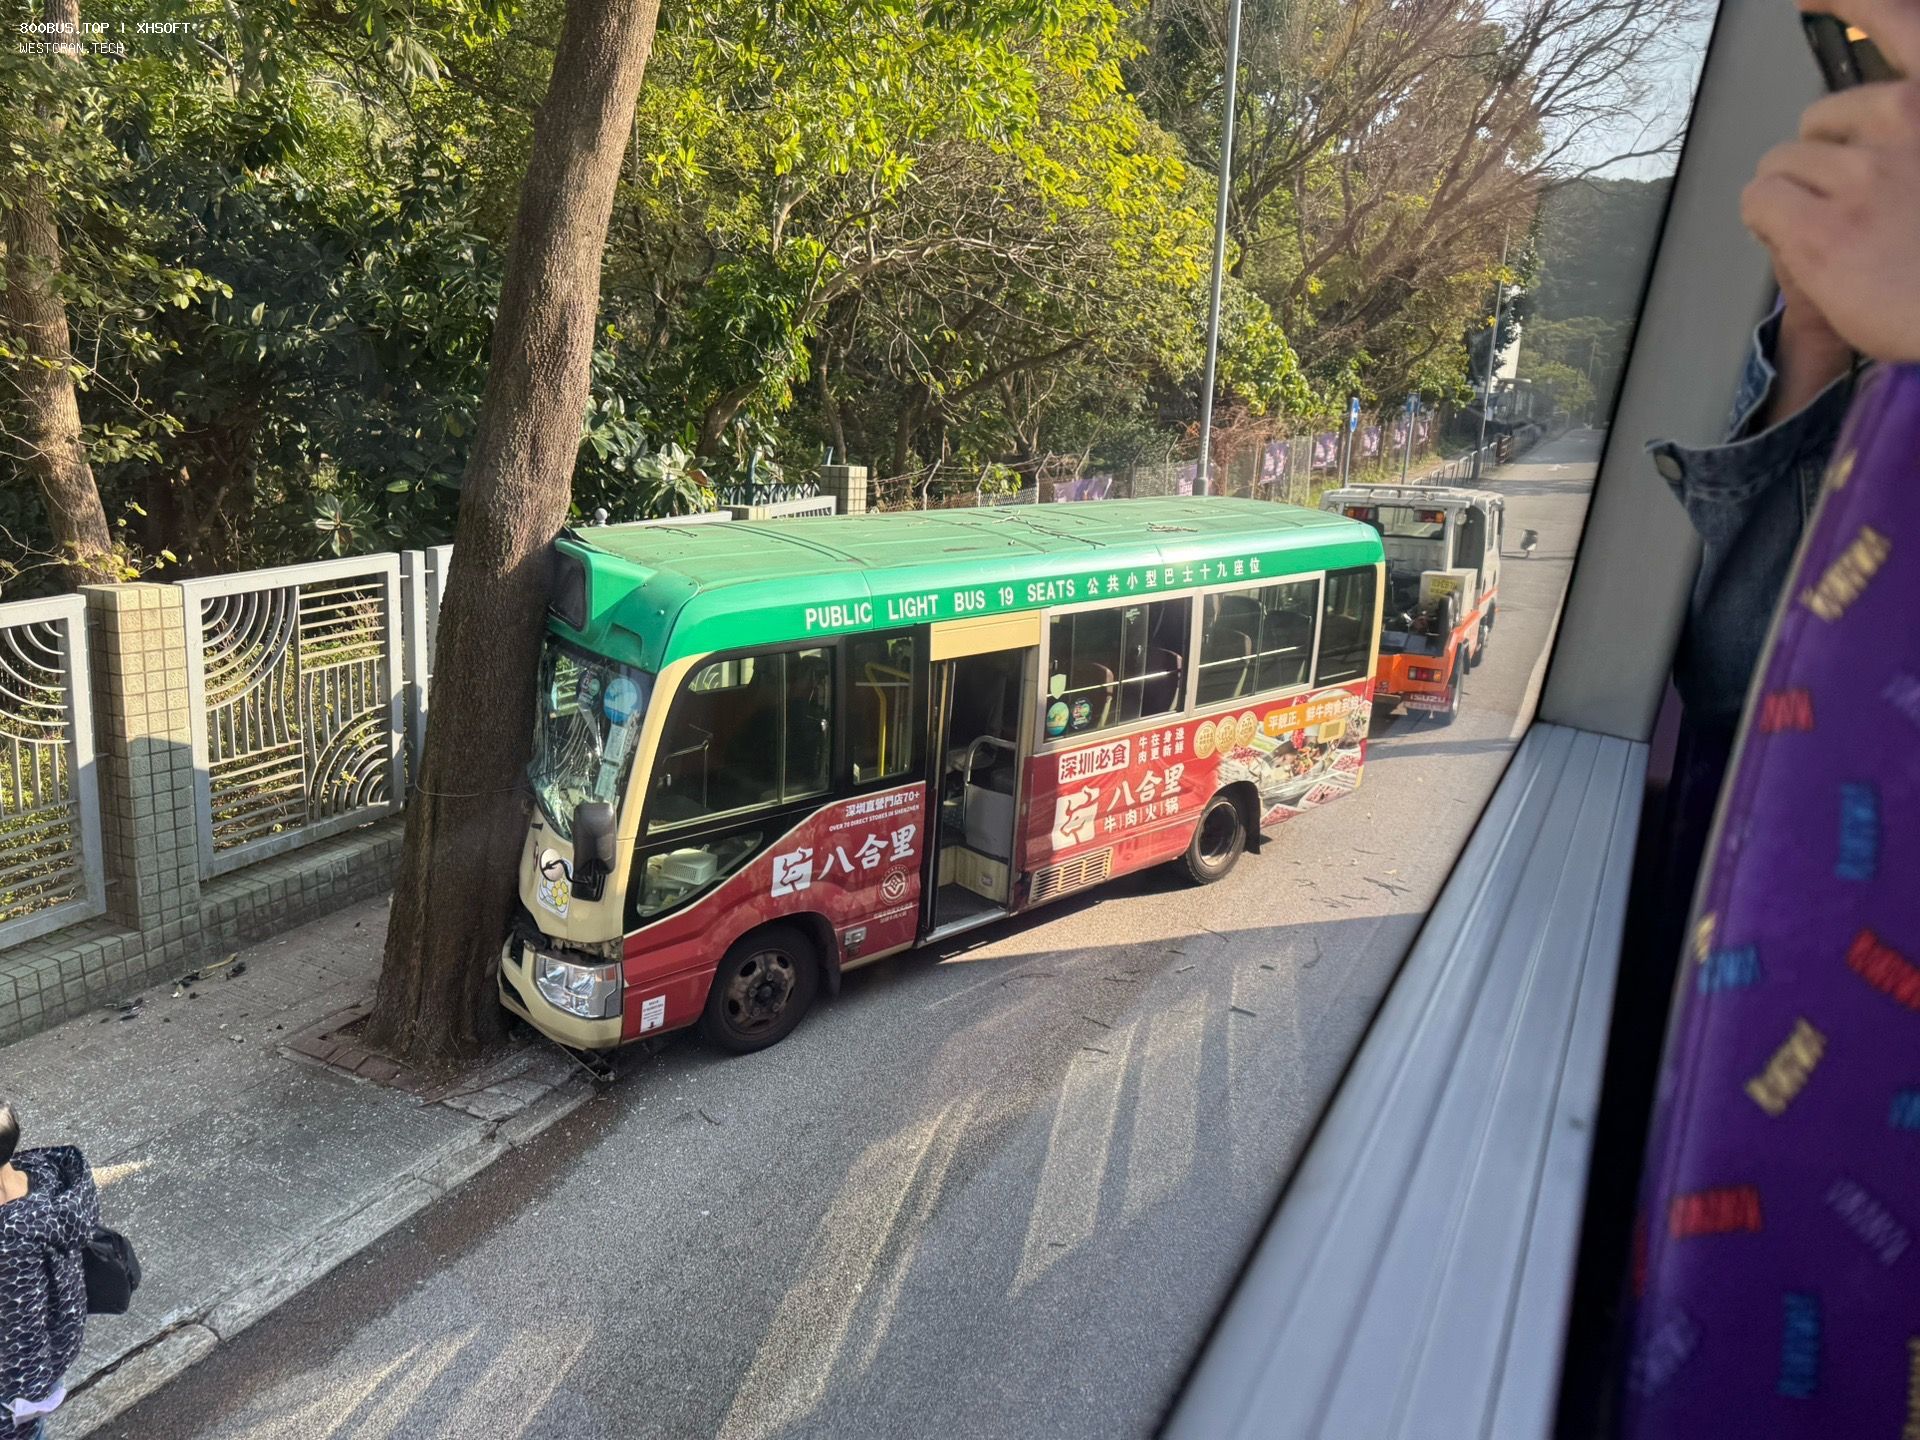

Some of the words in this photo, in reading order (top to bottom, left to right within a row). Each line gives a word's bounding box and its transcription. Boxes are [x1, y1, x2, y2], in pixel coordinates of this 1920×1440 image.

[805, 602, 873, 630] PUBLIC
[888, 594, 938, 620] LIGHT
[954, 590, 985, 612] BUS
[998, 586, 1014, 606] 19
[1027, 579, 1075, 602] SEATS
[1410, 693, 1446, 703] ISUZU
[1061, 744, 1126, 780] 深圳必食
[1106, 762, 1185, 814] 八合里
[818, 823, 917, 881] 八合里
